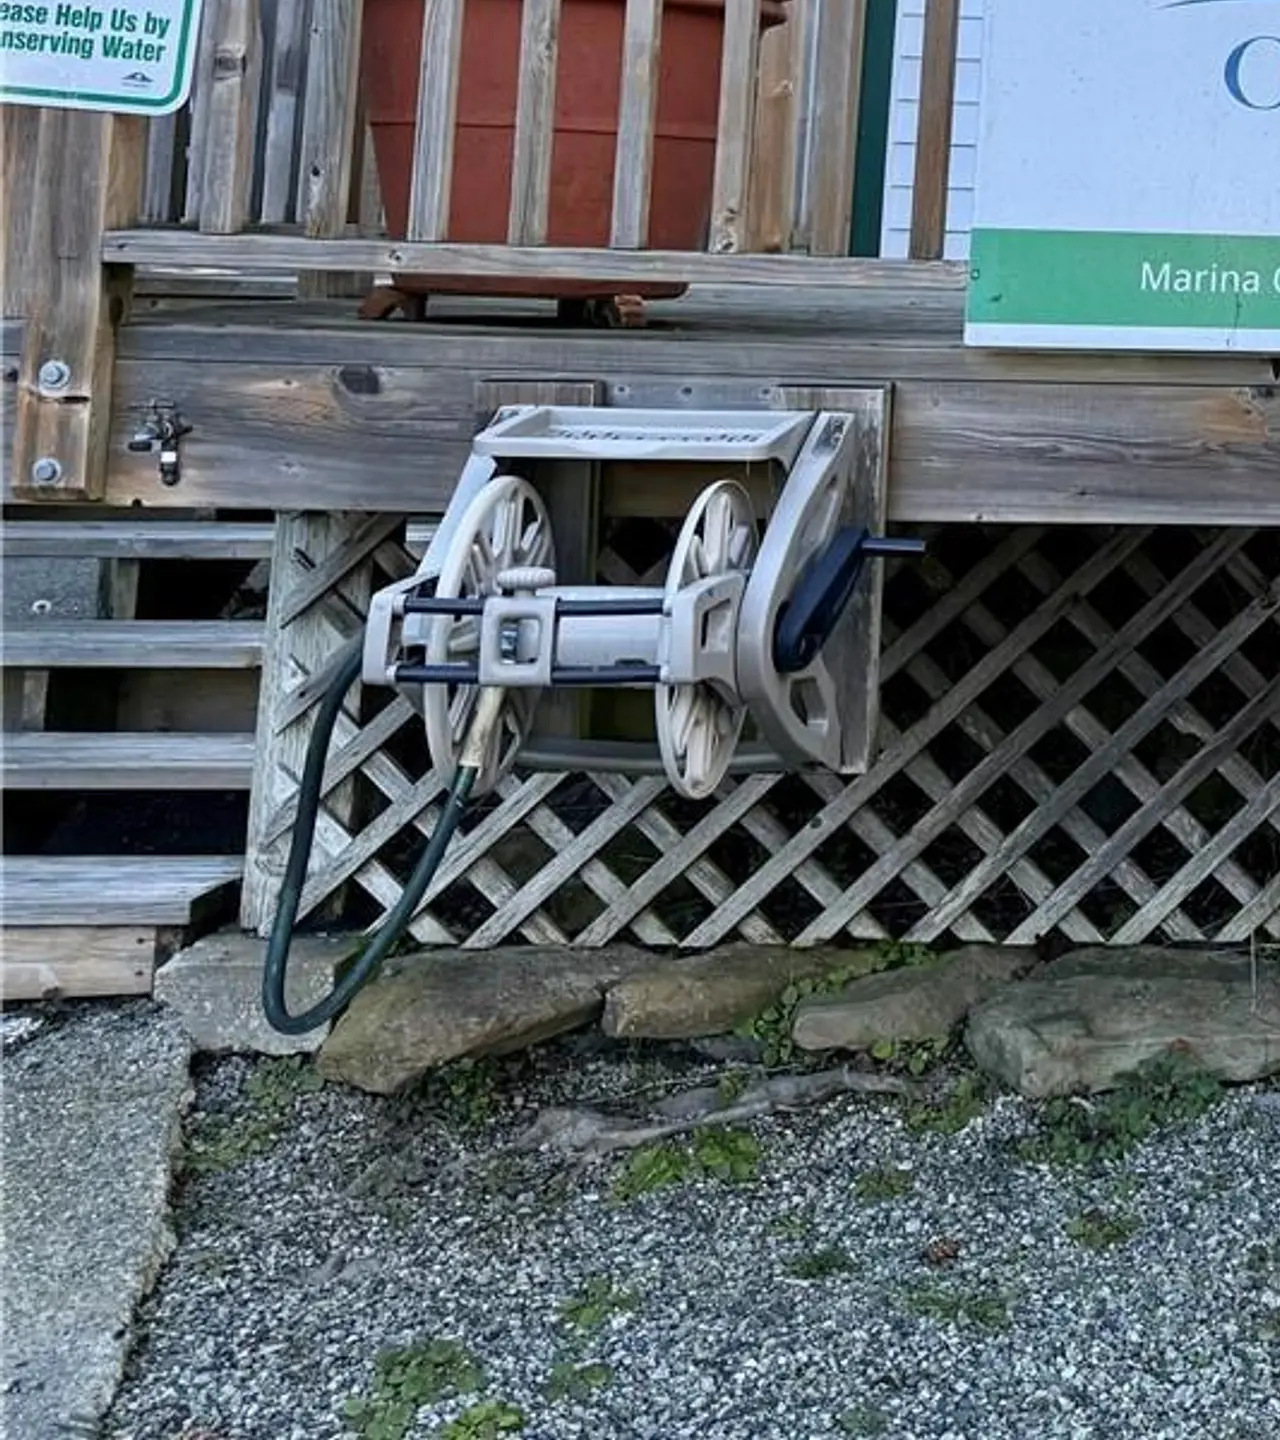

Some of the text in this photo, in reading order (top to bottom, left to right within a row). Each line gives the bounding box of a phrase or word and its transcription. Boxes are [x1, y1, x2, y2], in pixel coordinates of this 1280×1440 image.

[55, 3, 103, 33] Help
[110, 8, 139, 33] Us
[144, 11, 171, 39] by
[102, 35, 167, 62] Water
[1139, 262, 1259, 294] Marina
